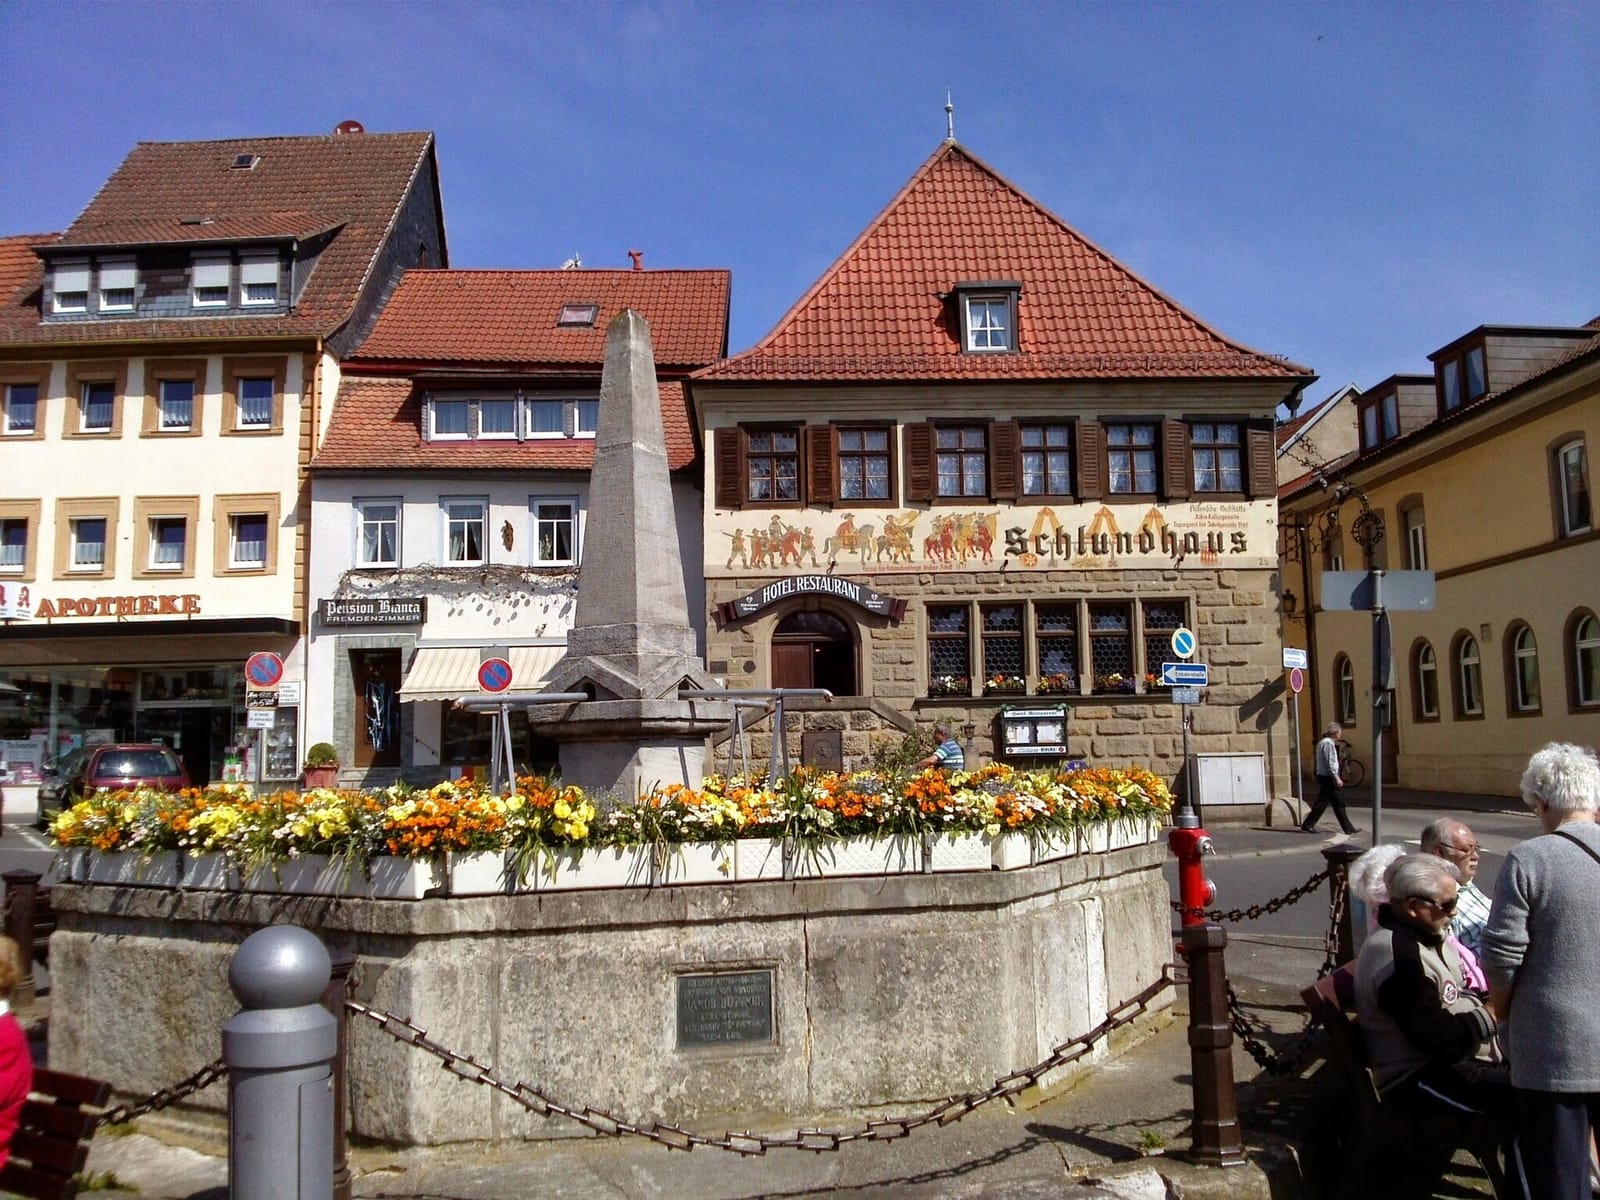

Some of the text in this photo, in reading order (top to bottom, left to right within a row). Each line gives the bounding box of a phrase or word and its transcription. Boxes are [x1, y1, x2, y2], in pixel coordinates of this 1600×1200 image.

[1004, 523, 1248, 560] Schlundhaus
[763, 575, 861, 603] HOTEL RESTAURANT
[34, 594, 201, 618] APOTHEKE
[326, 600, 420, 616] Pension Bianca
